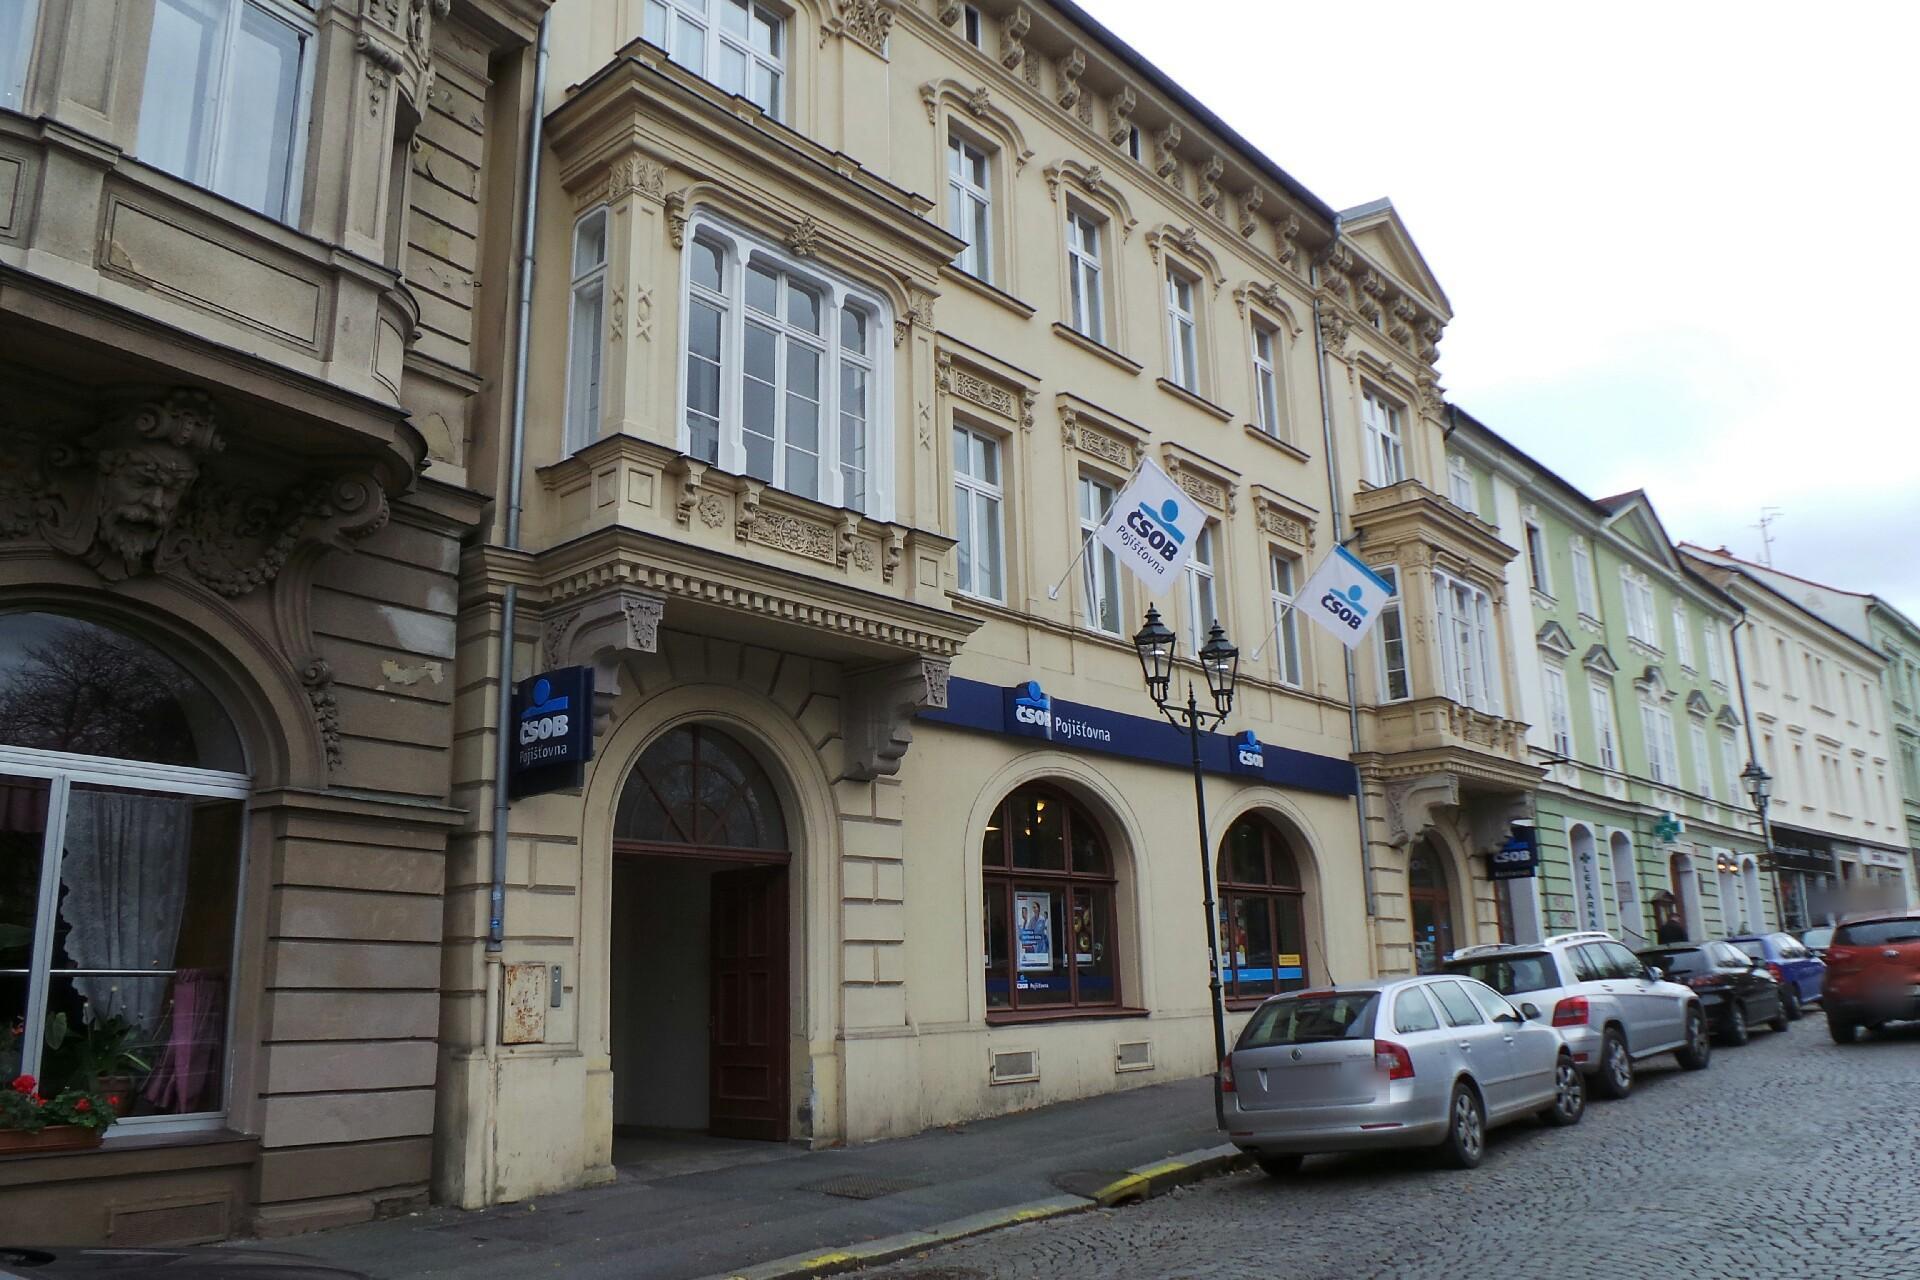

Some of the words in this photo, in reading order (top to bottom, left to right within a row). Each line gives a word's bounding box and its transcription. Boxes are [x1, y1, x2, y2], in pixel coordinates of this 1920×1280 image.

[1116, 525, 1165, 574] Pojišťovna
[1127, 509, 1178, 561] ČSOB
[1321, 593, 1362, 630] ČSOB
[519, 714, 568, 745] ČSOB
[1016, 705, 1051, 728] ČSOB
[1055, 717, 1111, 741] Pojišťovna
[519, 744, 567, 765] Pojišťovna
